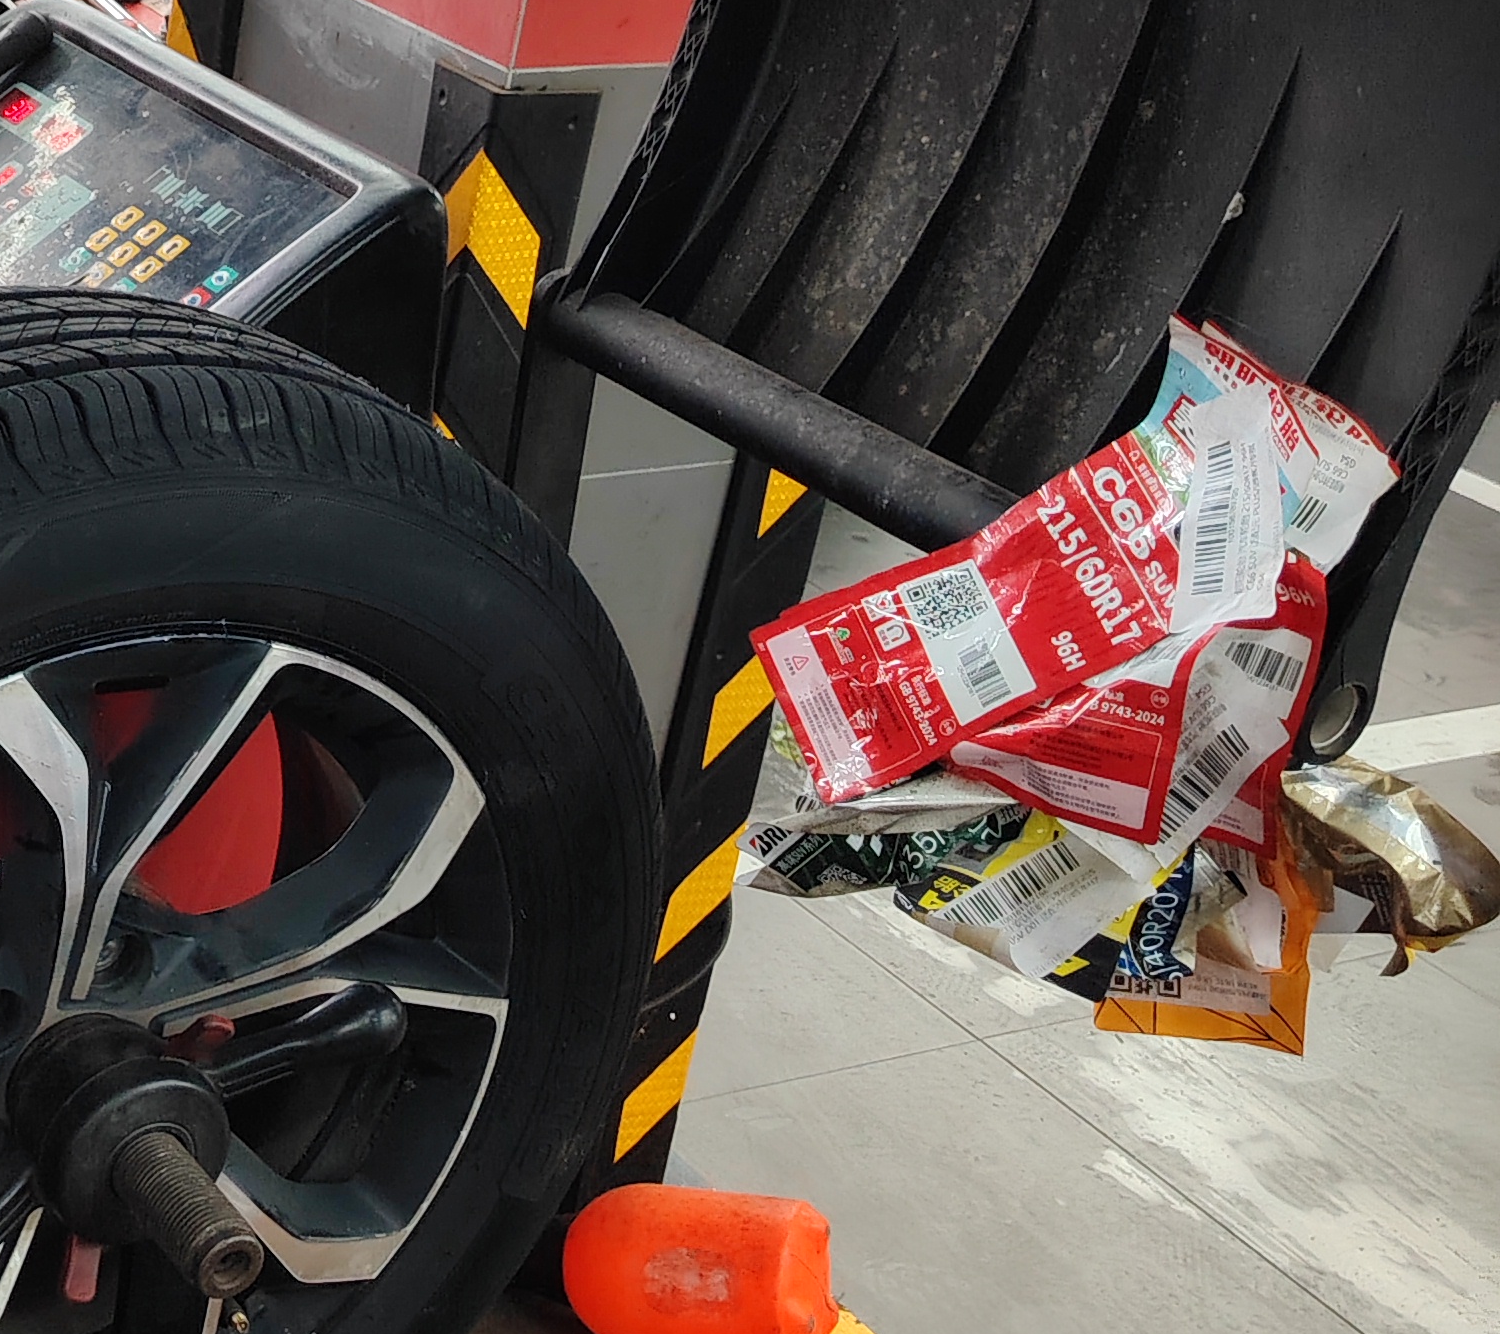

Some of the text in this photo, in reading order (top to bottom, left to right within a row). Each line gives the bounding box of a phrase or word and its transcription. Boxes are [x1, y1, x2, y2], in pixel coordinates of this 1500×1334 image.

[1093, 466, 1157, 560] C66
[1036, 495, 1142, 646] 215/60R17
[1277, 583, 1315, 607] 96H
[1051, 630, 1087, 672] 96H
[897, 679, 939, 746] GB 9743-2024
[1099, 699, 1165, 728] 9743-2024
